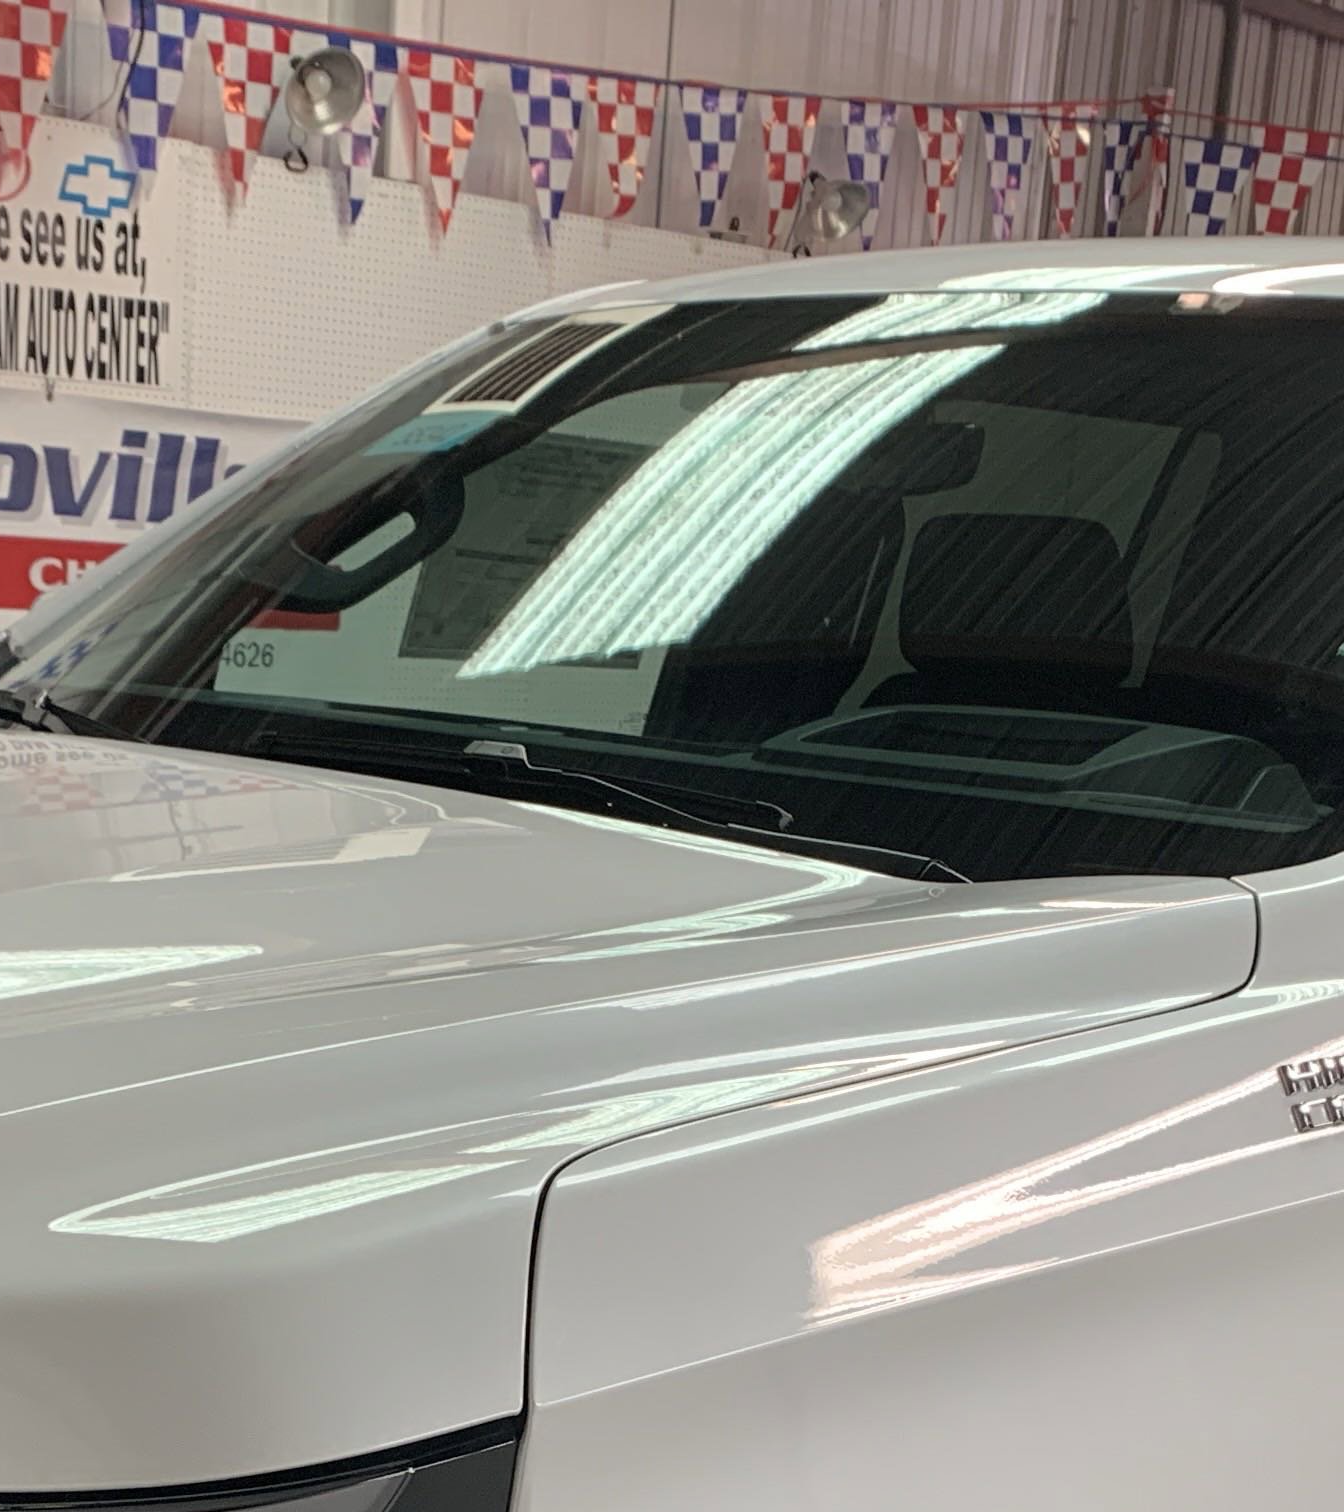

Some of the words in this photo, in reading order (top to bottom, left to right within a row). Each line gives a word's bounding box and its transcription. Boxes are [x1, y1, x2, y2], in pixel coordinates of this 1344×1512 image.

[20, 207, 66, 268] see
[76, 216, 105, 272] us
[114, 210, 147, 294] at,
[25, 285, 77, 379] AUTO
[84, 291, 169, 386] CENTER"
